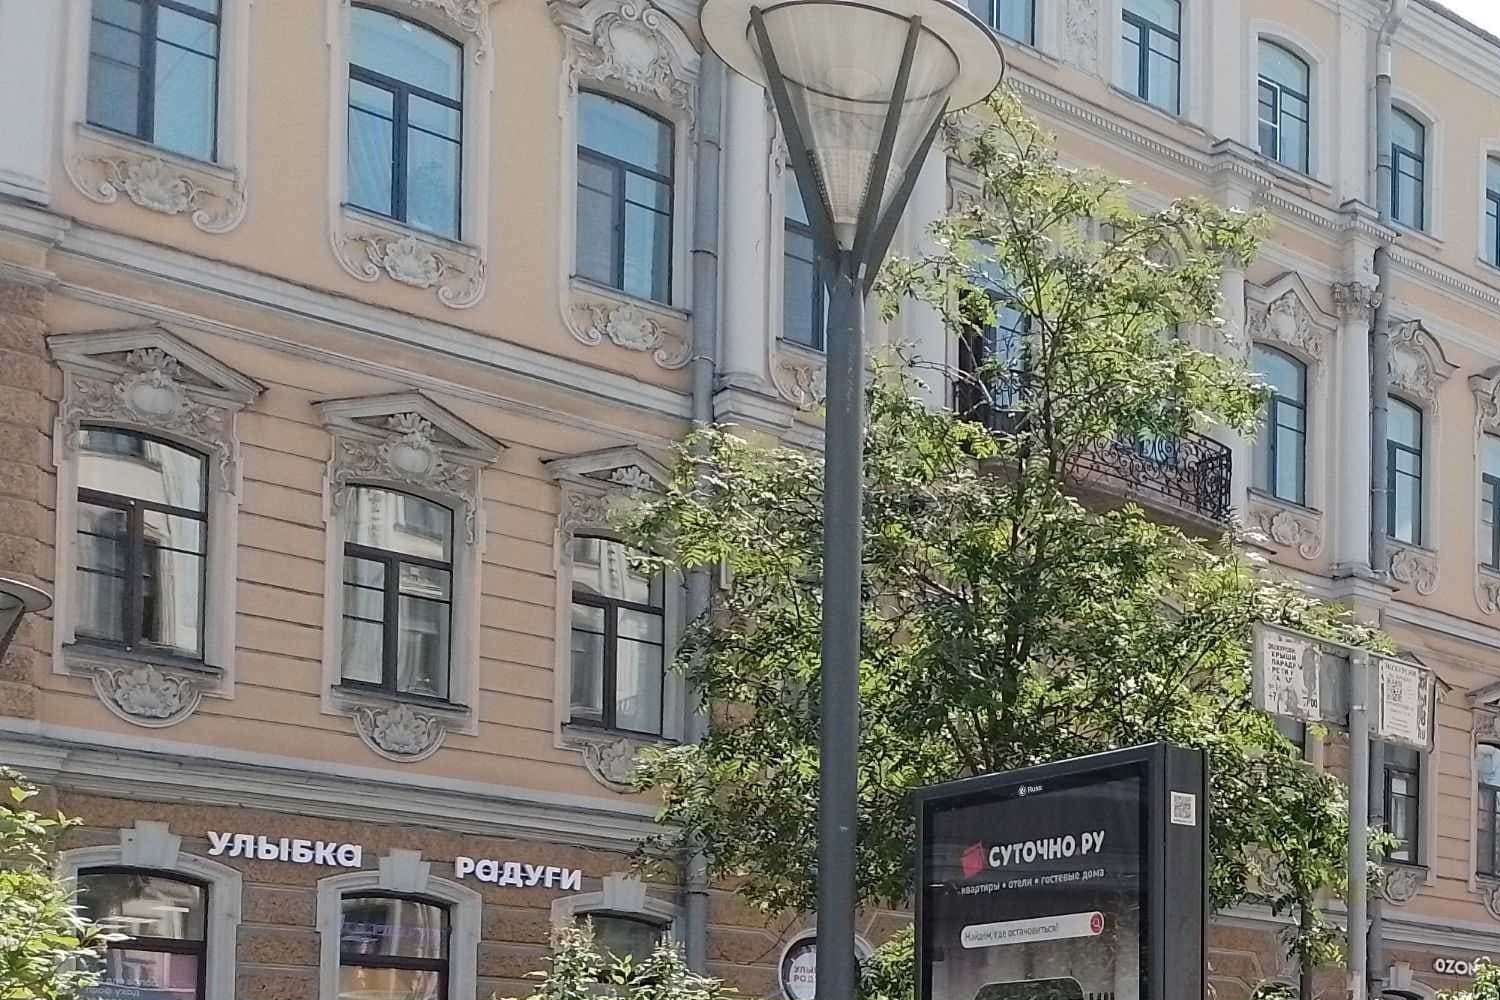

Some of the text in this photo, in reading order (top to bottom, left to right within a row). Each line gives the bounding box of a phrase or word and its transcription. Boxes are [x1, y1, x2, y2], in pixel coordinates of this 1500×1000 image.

[961, 868, 1105, 896] квартиры отели гостевые дома
